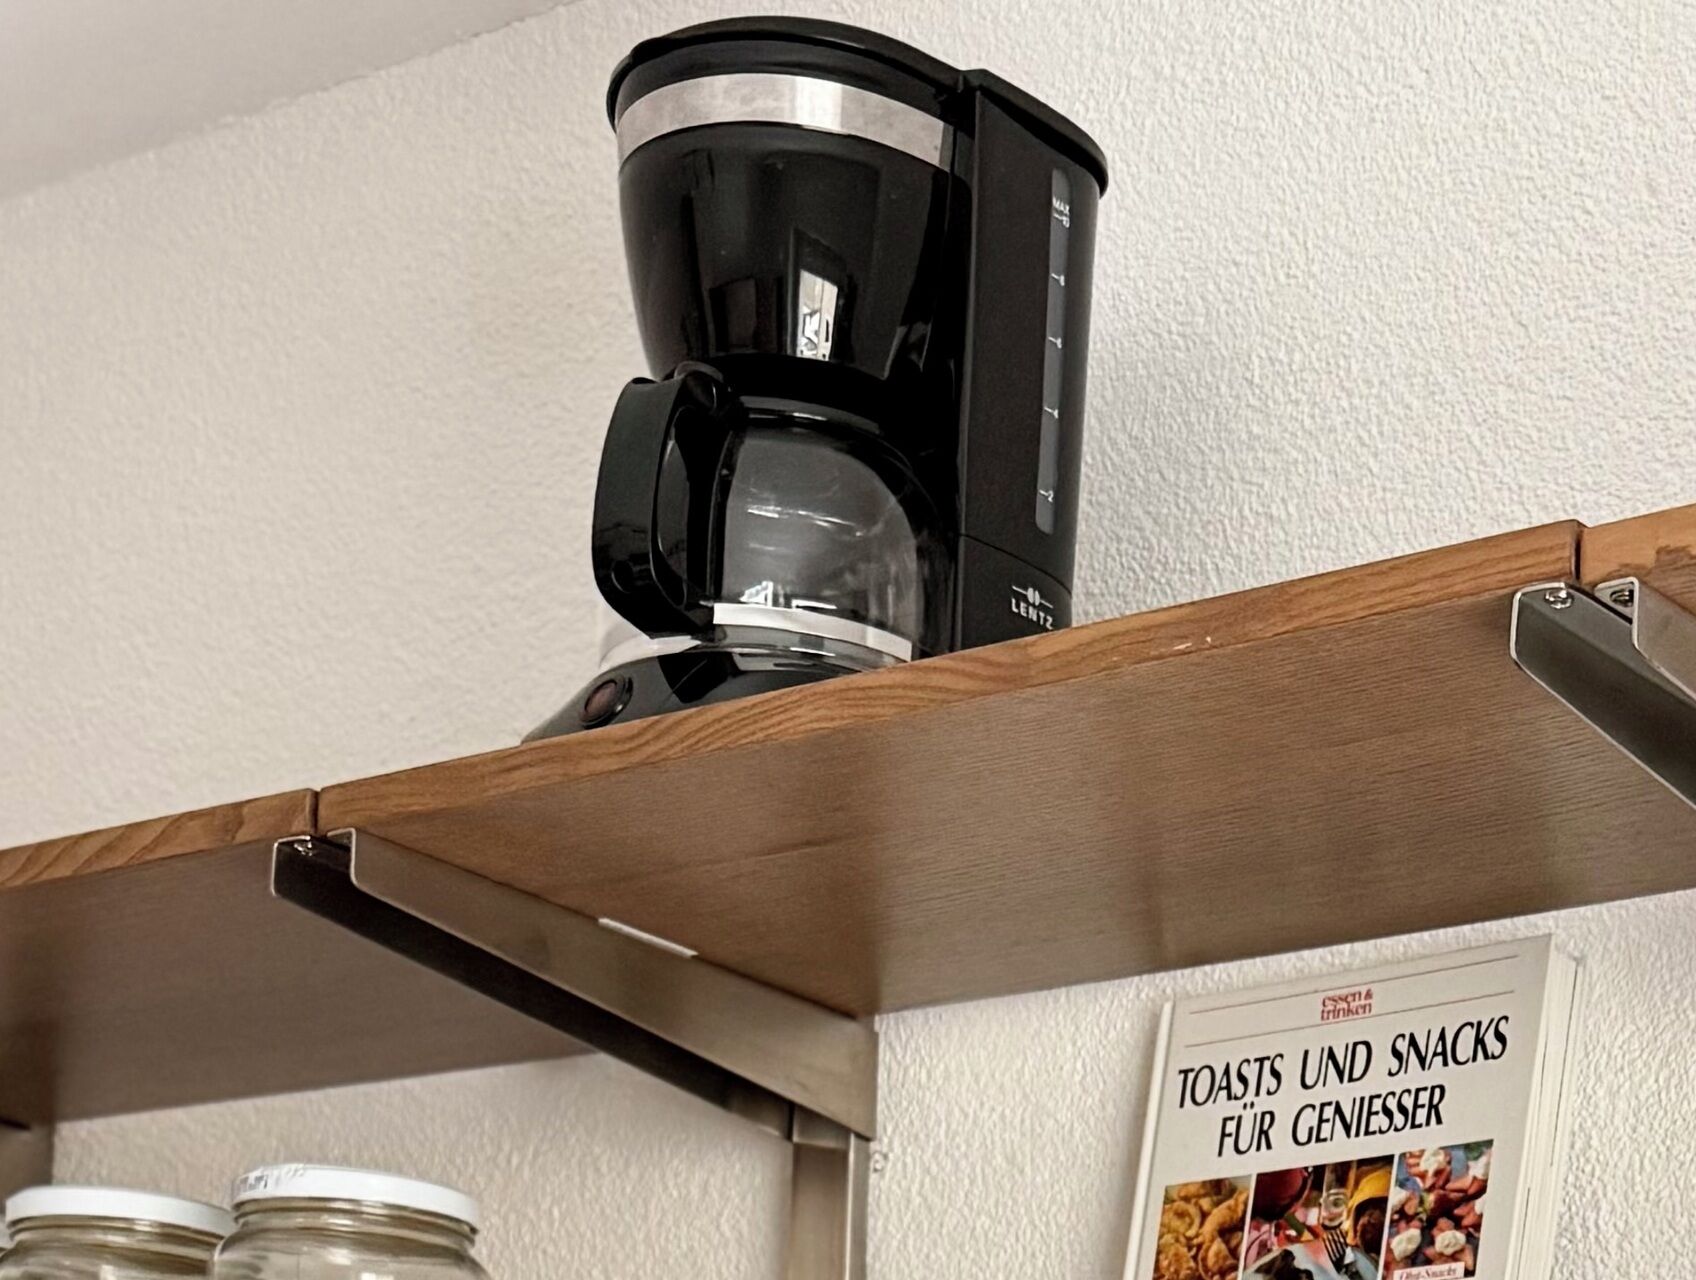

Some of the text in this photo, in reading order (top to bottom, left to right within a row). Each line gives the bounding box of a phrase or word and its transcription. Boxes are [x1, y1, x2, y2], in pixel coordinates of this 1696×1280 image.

[1011, 597, 1054, 630] LENTZ
[1320, 1002, 1372, 1021] trinken
[1322, 988, 1373, 1008] essen &
[1178, 1015, 1510, 1109] TOASTS UND SNACKS
[1217, 1083, 1447, 1158] FÜR GENIESSER
